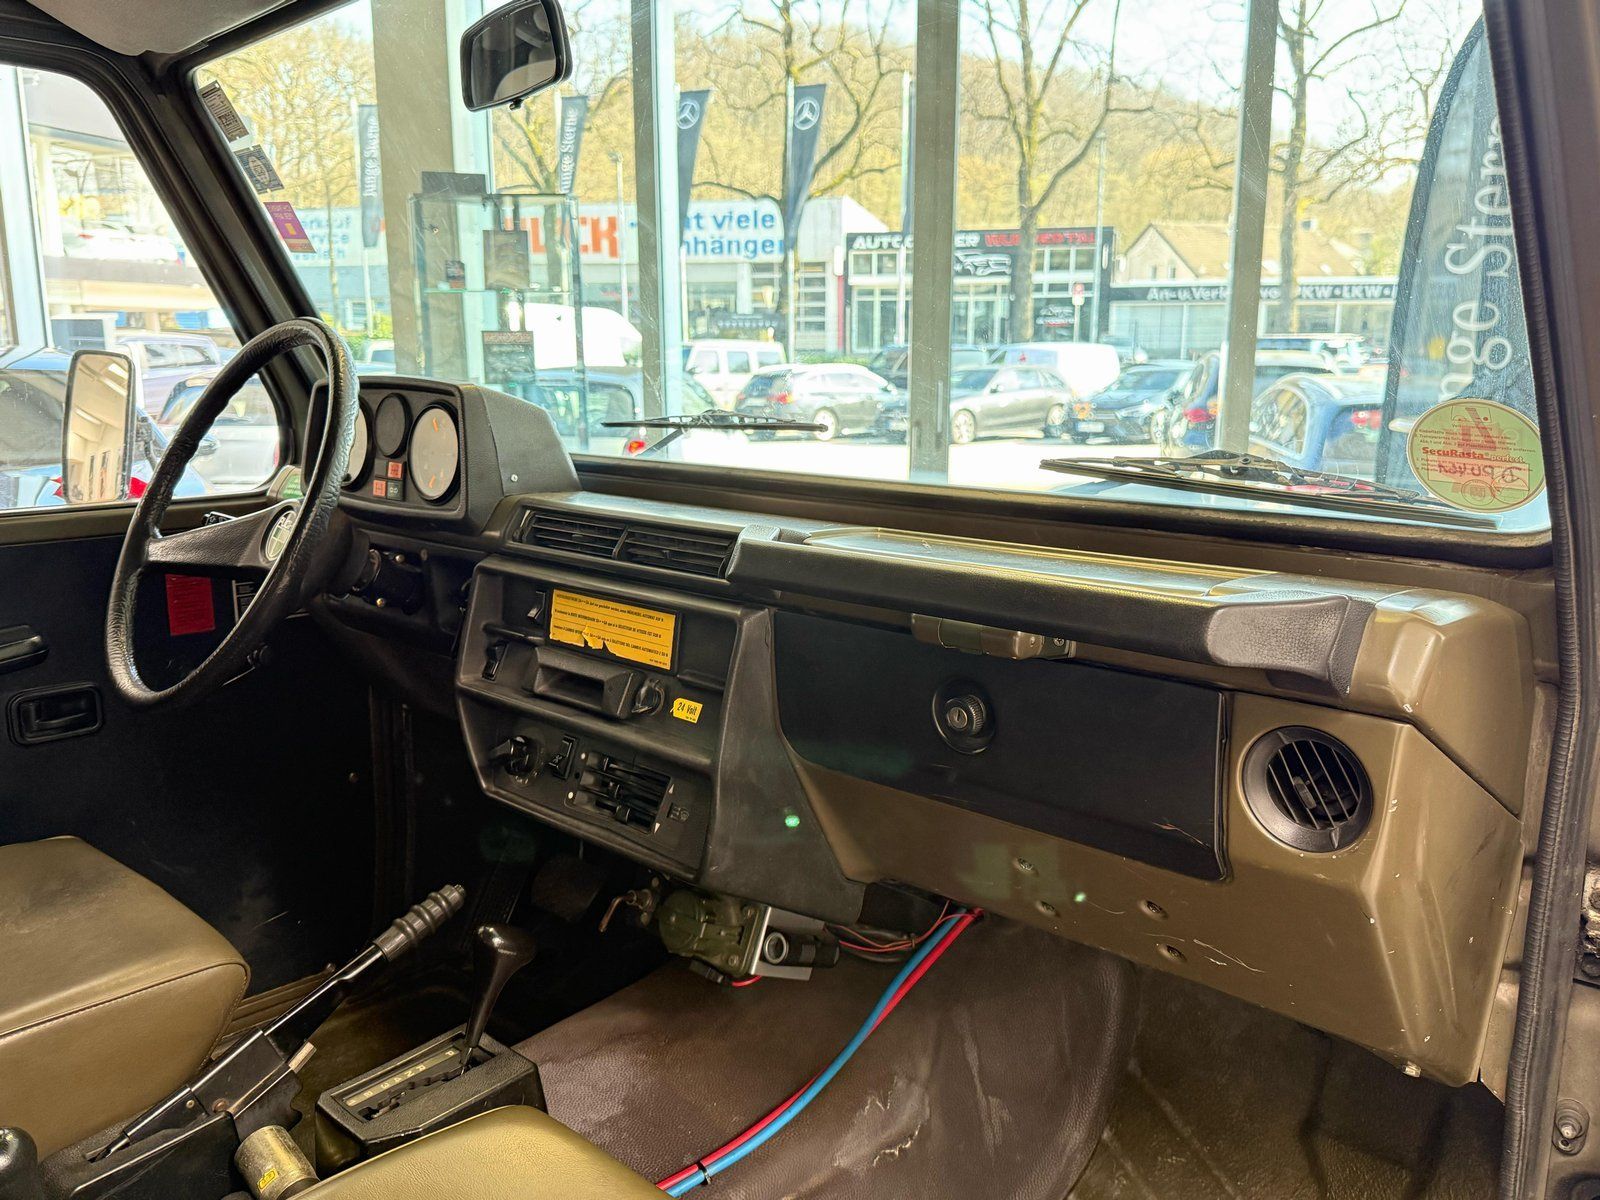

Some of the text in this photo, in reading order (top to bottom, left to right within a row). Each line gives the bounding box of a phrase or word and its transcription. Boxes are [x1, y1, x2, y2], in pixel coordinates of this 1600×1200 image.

[713, 210, 775, 230] viele
[1422, 446, 1484, 460] SecuRasta
[677, 701, 698, 716] 24 Volt
